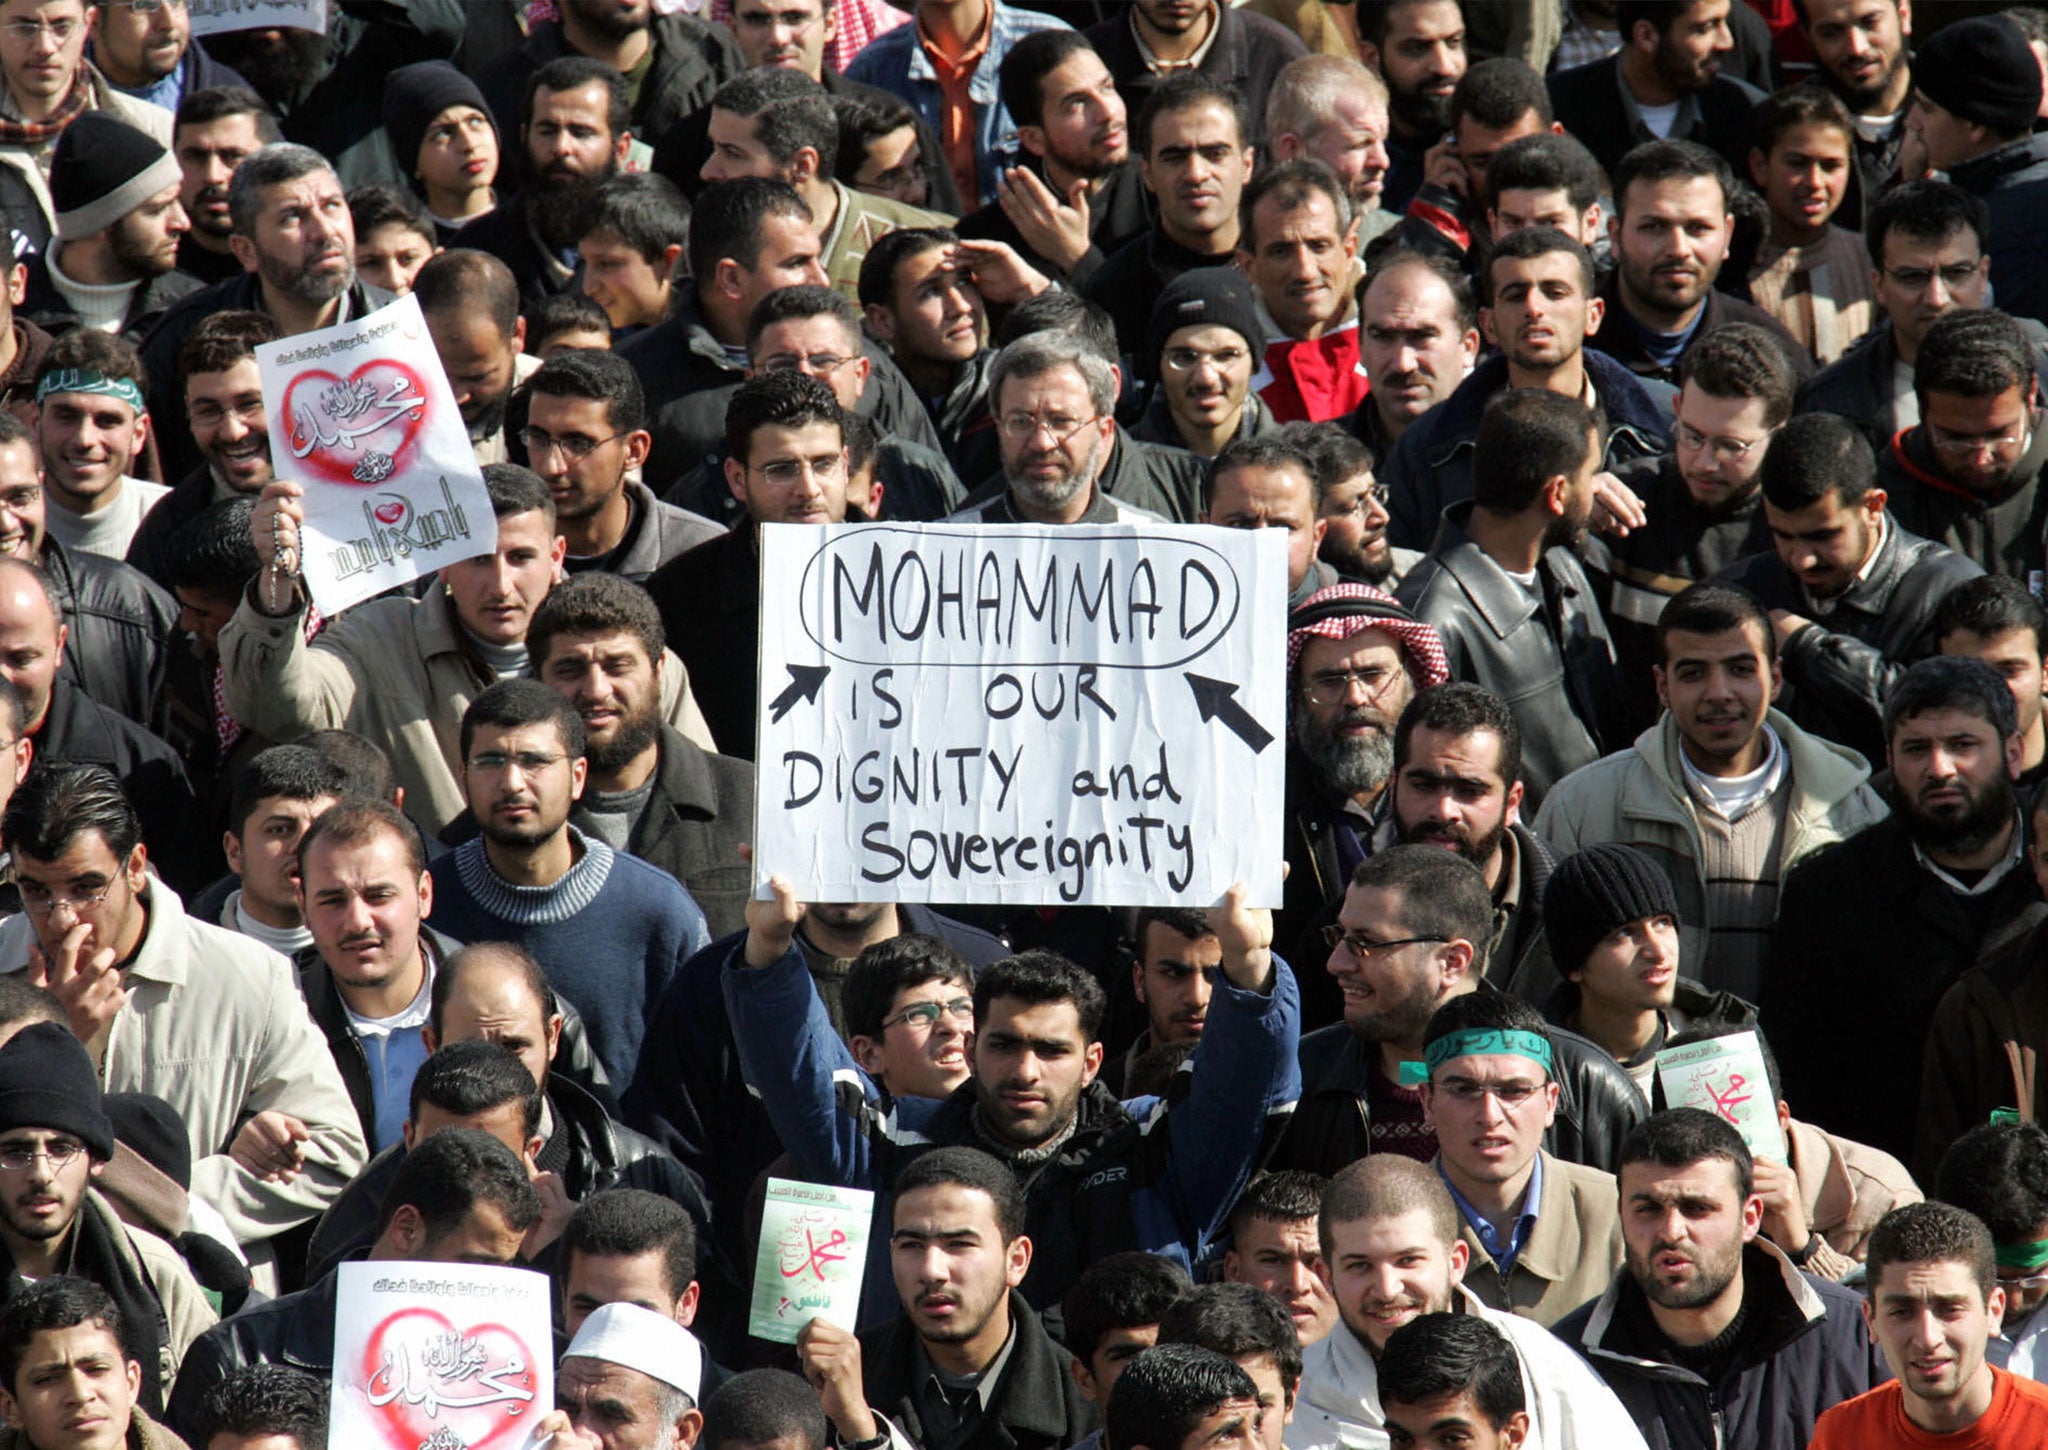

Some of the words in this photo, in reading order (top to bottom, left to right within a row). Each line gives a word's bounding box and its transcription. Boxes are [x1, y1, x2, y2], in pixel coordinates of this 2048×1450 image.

[290, 376, 426, 459] محمد
[833, 541, 1220, 648] MOHAMMAD
[852, 668, 902, 729] IS
[984, 665, 1116, 721] OUR
[783, 744, 1023, 812] DIGNITY
[1072, 742, 1182, 805] and
[861, 814, 1194, 903] Sovereignity
[779, 1226, 847, 1282] محمد
[366, 1342, 535, 1420] محمد
